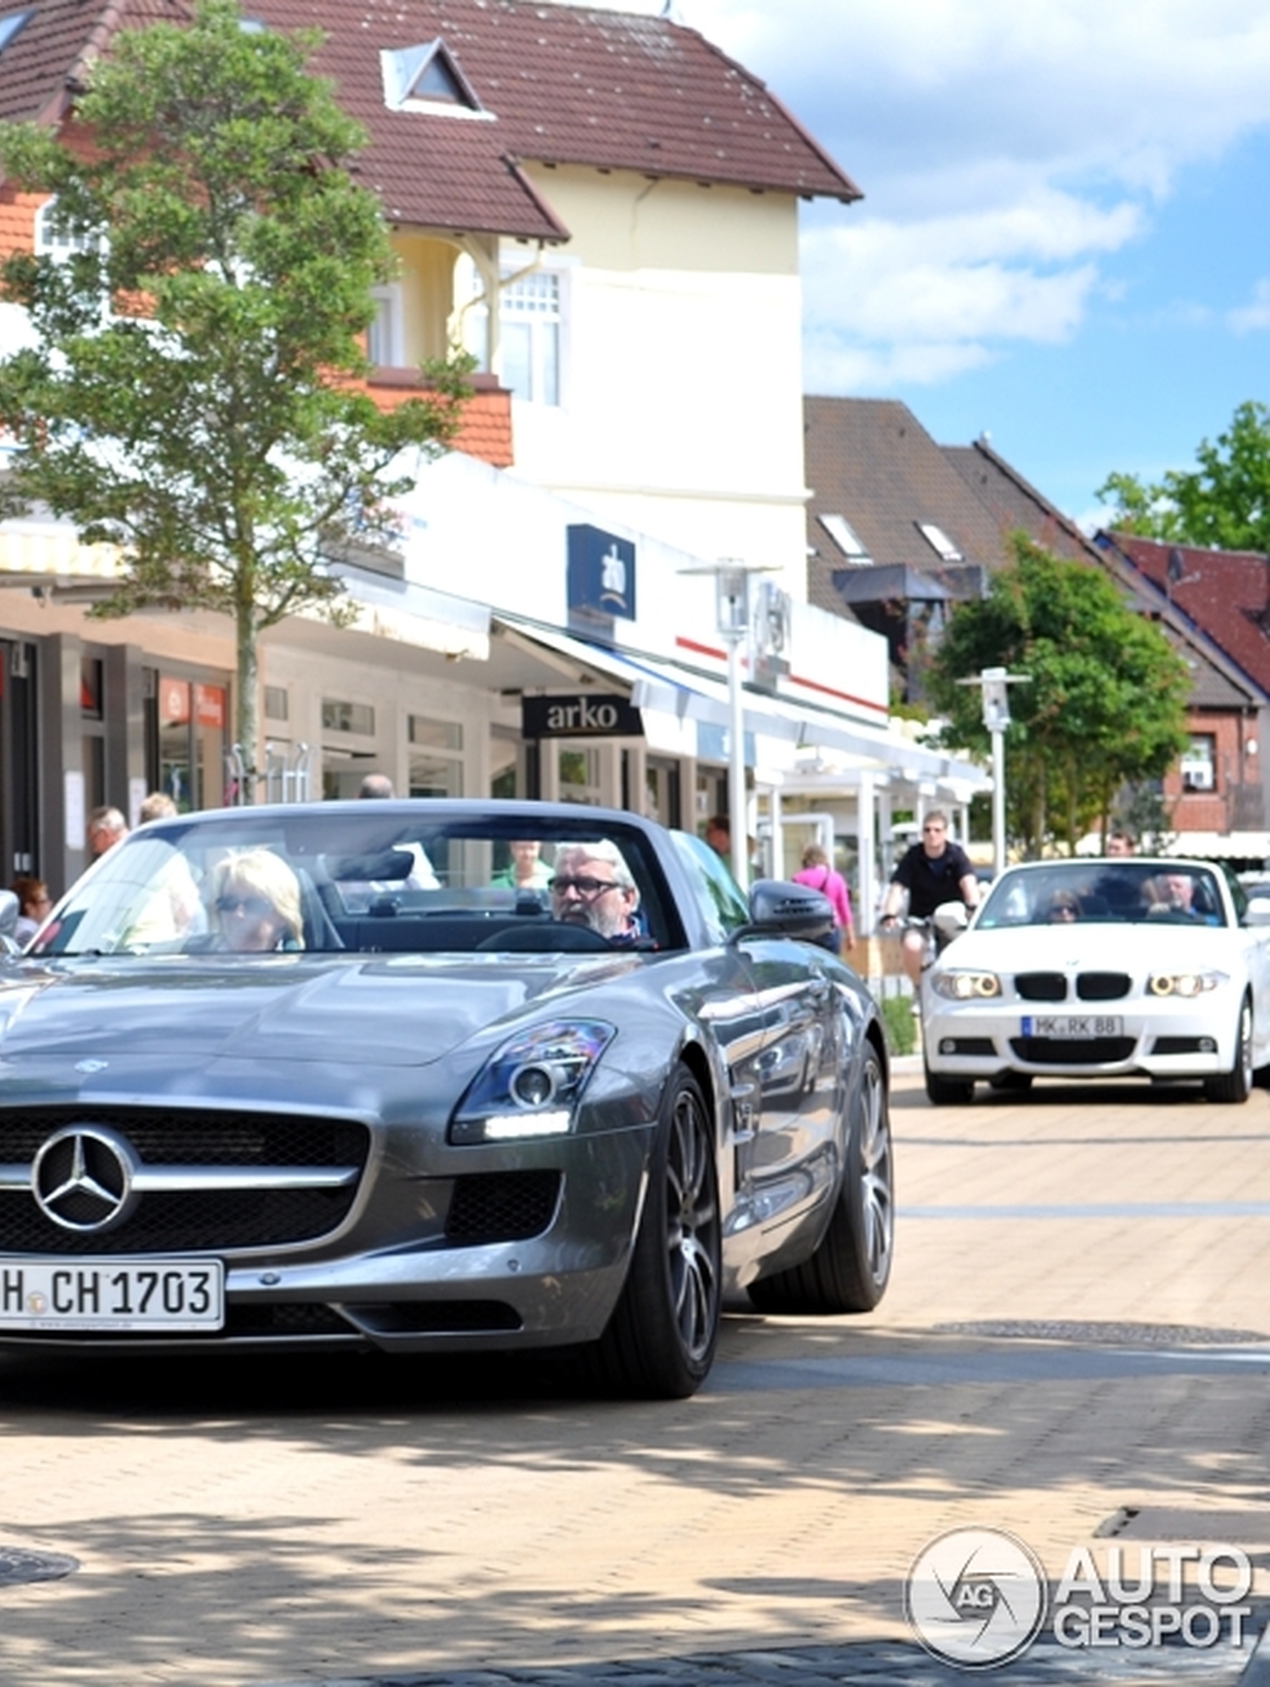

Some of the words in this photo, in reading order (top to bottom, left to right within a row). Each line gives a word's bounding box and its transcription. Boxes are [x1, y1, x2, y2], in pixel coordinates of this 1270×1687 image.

[547, 697, 619, 729] arko
[51, 1271, 100, 1314] CH
[112, 1271, 211, 1314] 1703
